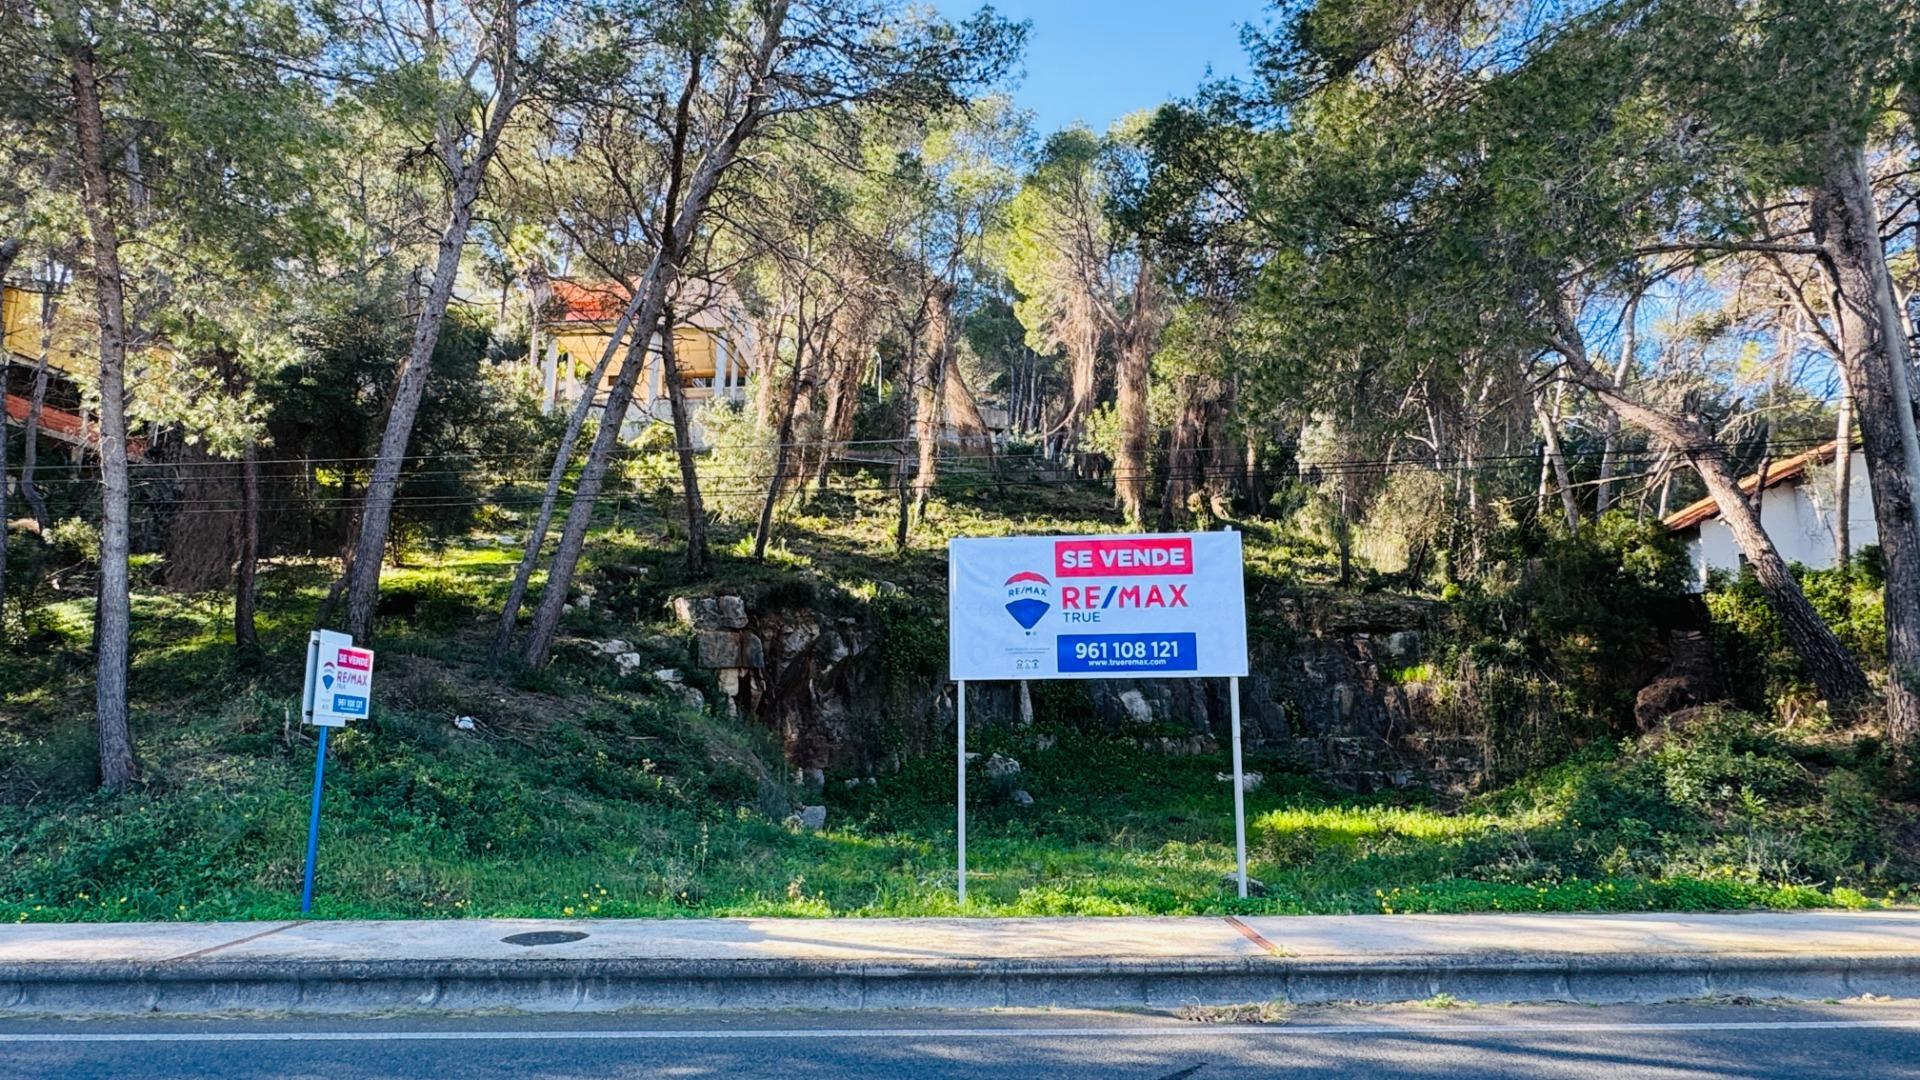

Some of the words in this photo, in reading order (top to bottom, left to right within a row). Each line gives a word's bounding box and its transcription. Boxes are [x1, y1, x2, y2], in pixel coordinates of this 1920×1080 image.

[1062, 550, 1093, 569] SE
[1099, 547, 1186, 568] VENDE
[1008, 586, 1047, 598] RE/MAX
[1061, 584, 1189, 610] RE/MAX
[1062, 611, 1101, 623] TRUE
[1075, 642, 1107, 659] 961
[1112, 641, 1146, 659] 108
[1150, 640, 1178, 658] 121
[349, 655, 369, 667] VENDE
[1088, 658, 1167, 667] www.trueremax.com
[337, 671, 368, 687] RE/MAX
